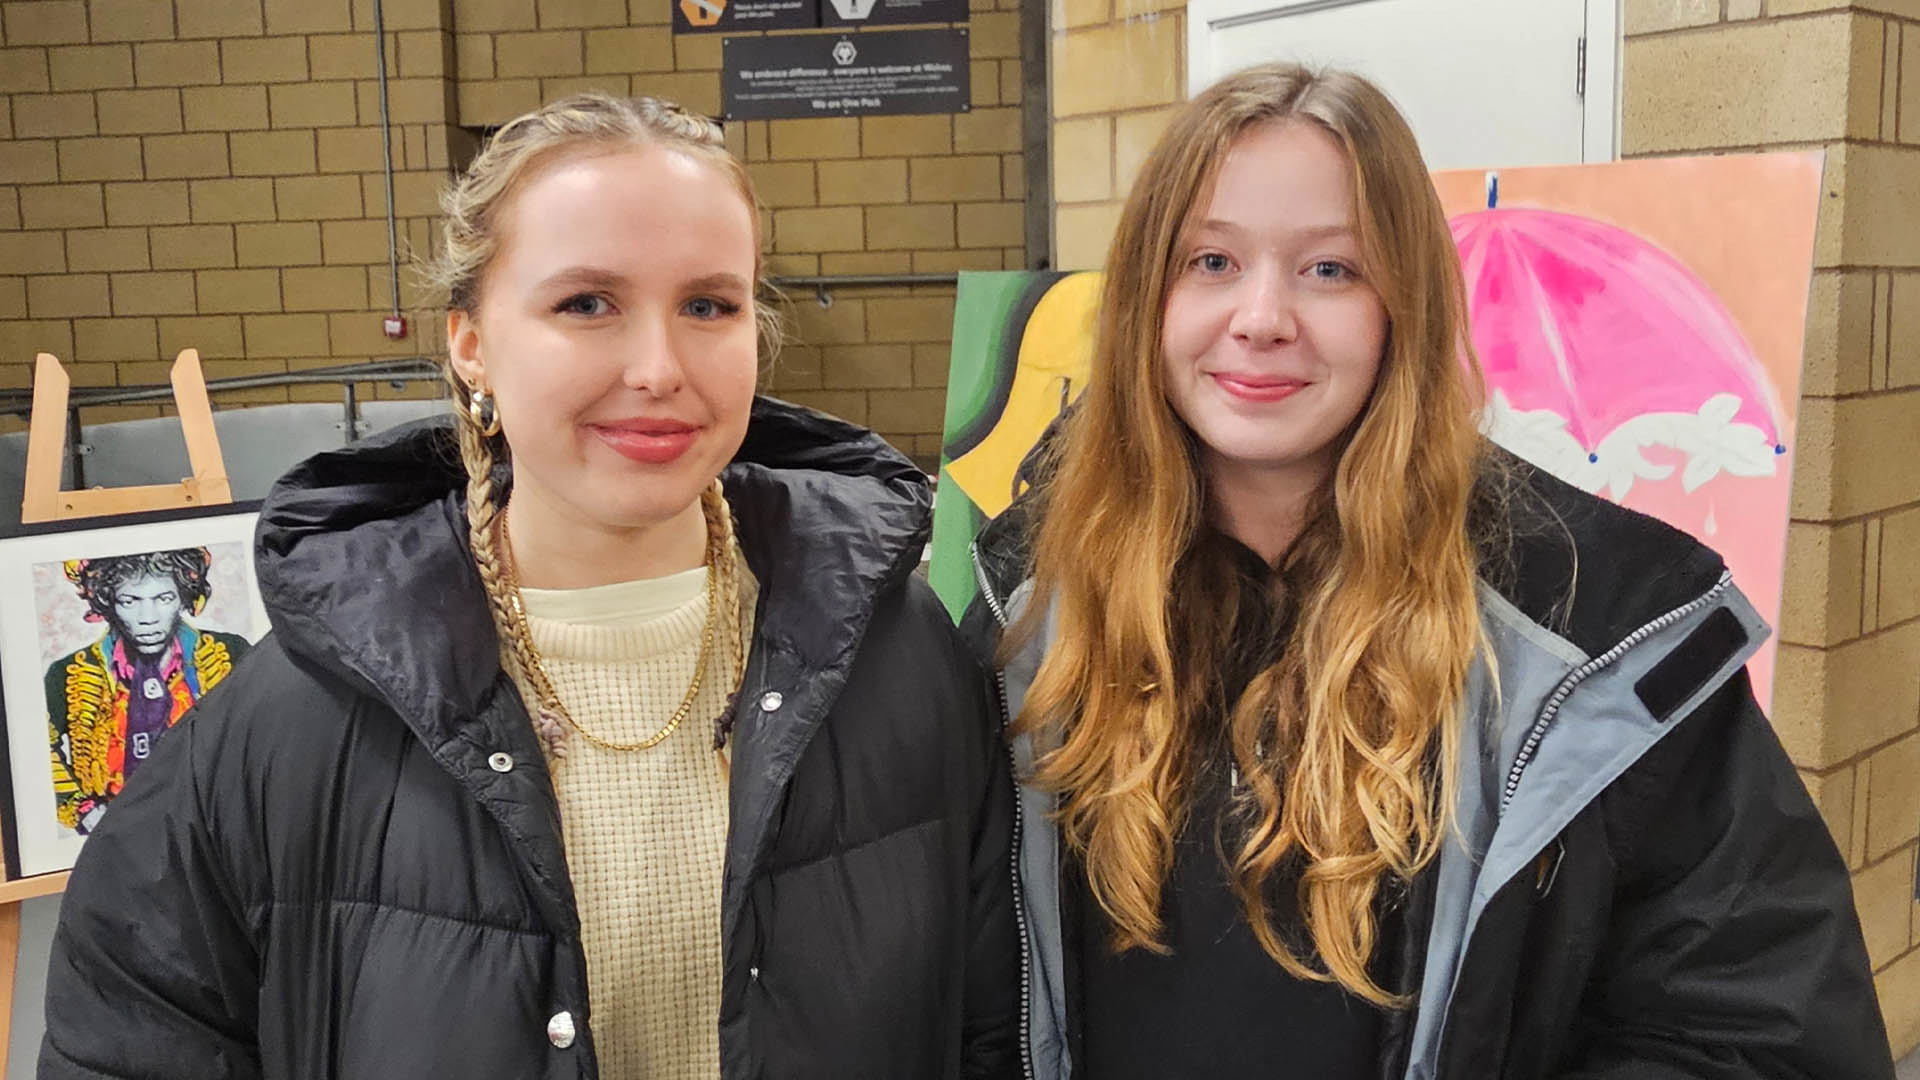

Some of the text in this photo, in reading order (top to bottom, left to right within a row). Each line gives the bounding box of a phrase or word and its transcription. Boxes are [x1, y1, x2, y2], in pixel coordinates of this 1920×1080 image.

[739, 70, 754, 79] We
[755, 69, 788, 78] embrace
[833, 67, 868, 77] everyone
[870, 66, 877, 74] is
[878, 65, 911, 74] welcome
[912, 64, 922, 73] at
[922, 63, 953, 72] Wolves
[812, 97, 881, 109] We are One Pack
